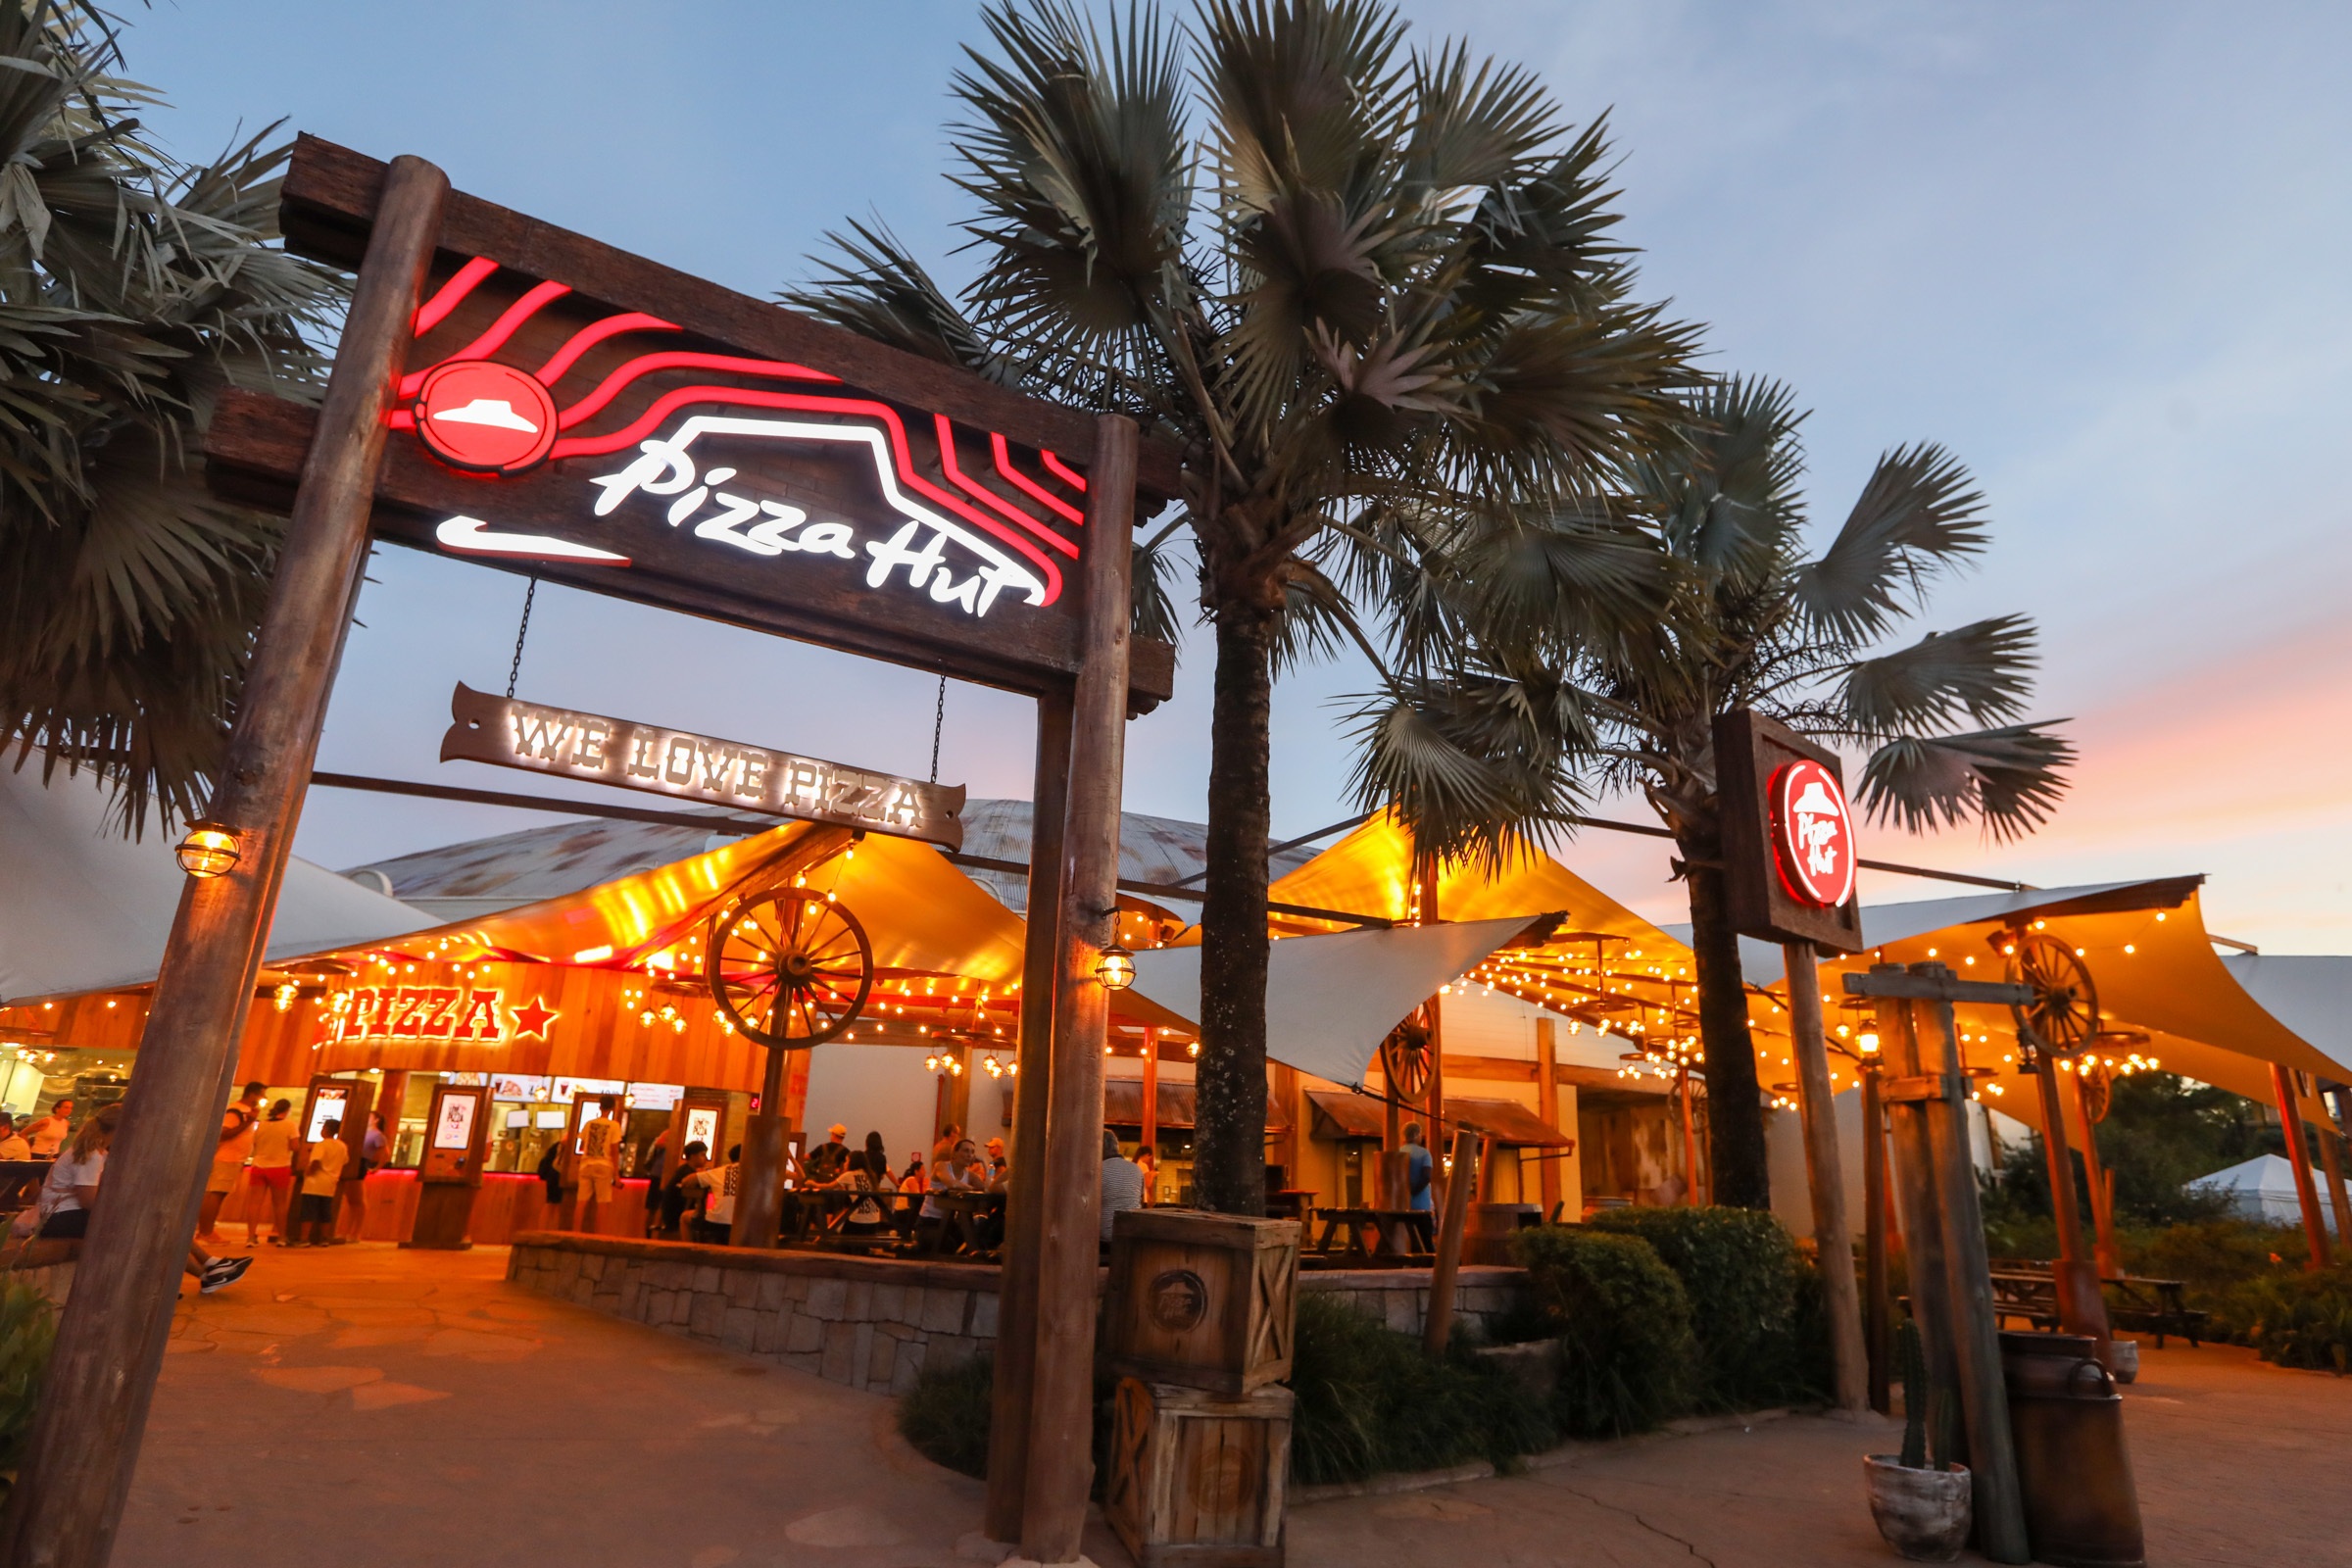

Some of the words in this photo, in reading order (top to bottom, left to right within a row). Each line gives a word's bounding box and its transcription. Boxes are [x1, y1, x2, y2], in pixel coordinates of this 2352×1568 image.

[590, 439, 856, 560] Pizza
[510, 703, 612, 769] WE
[627, 728, 768, 802] LOVE
[784, 759, 924, 828] PIZZA
[341, 986, 506, 1042] PIZZA
